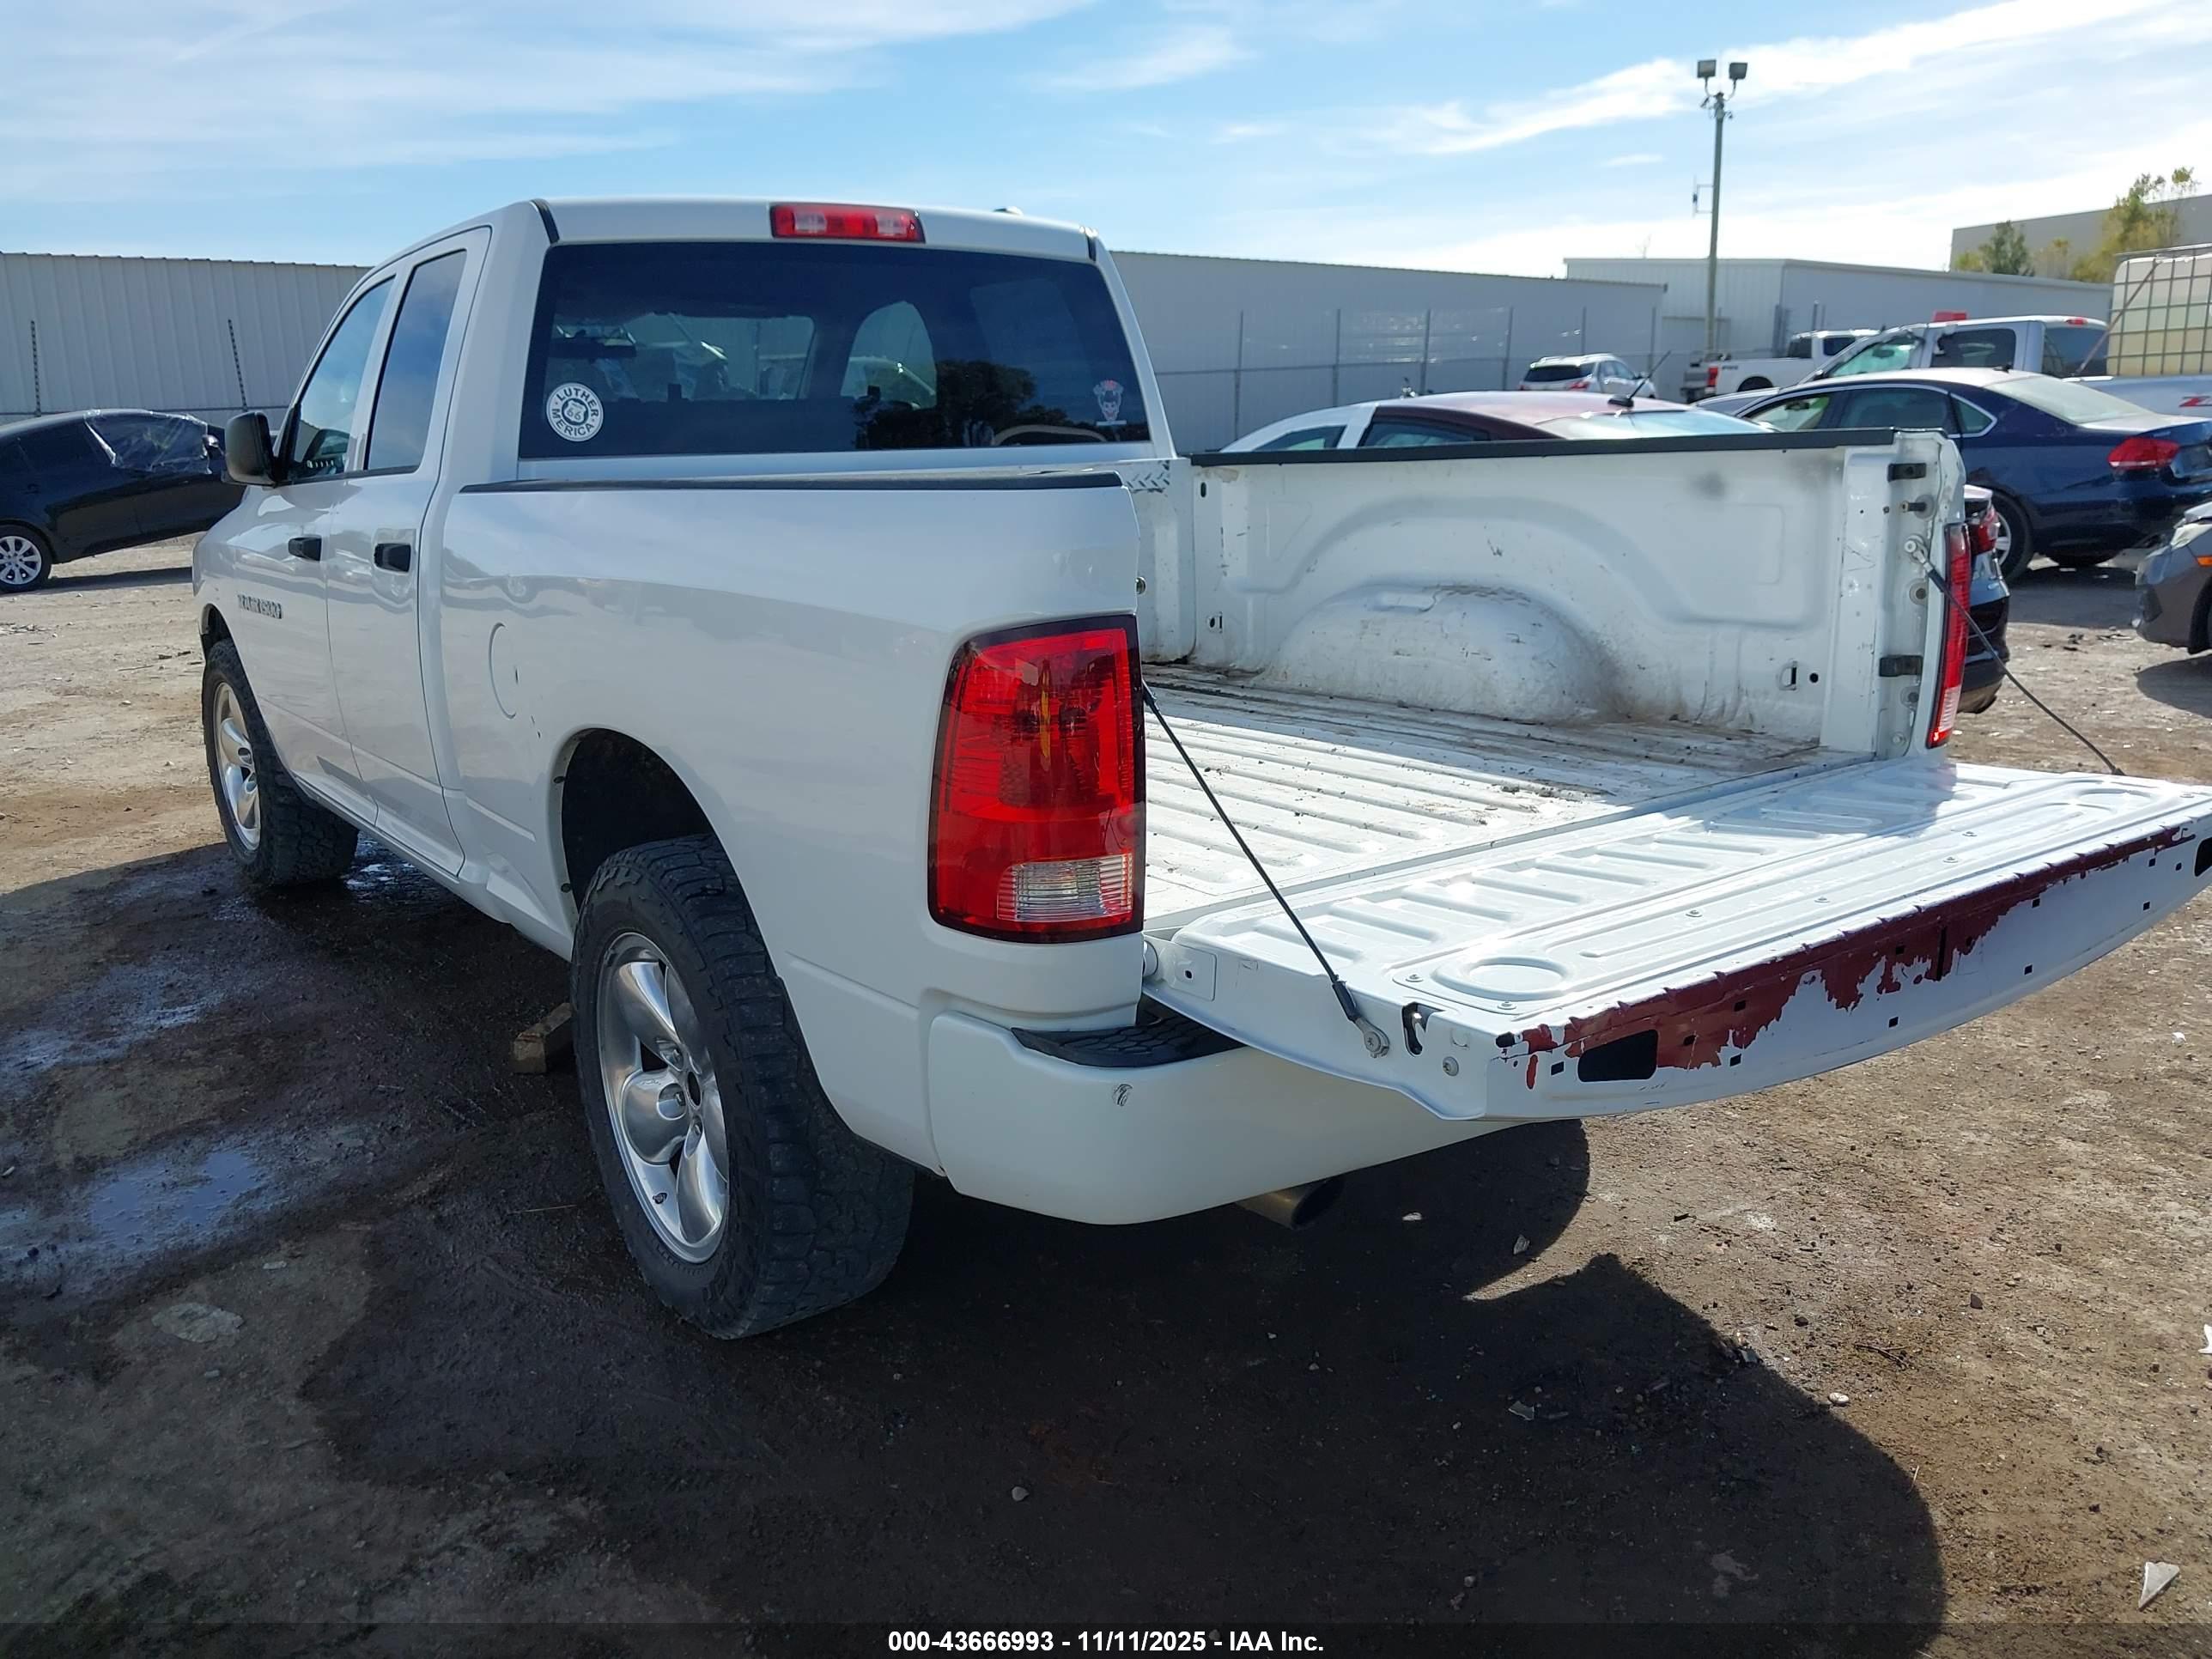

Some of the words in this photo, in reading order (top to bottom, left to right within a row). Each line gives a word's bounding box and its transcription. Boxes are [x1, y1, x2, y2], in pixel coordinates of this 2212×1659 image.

[556, 387, 599, 417] LUTHER
[567, 408, 581, 421] 66
[551, 408, 595, 436] MERICA
